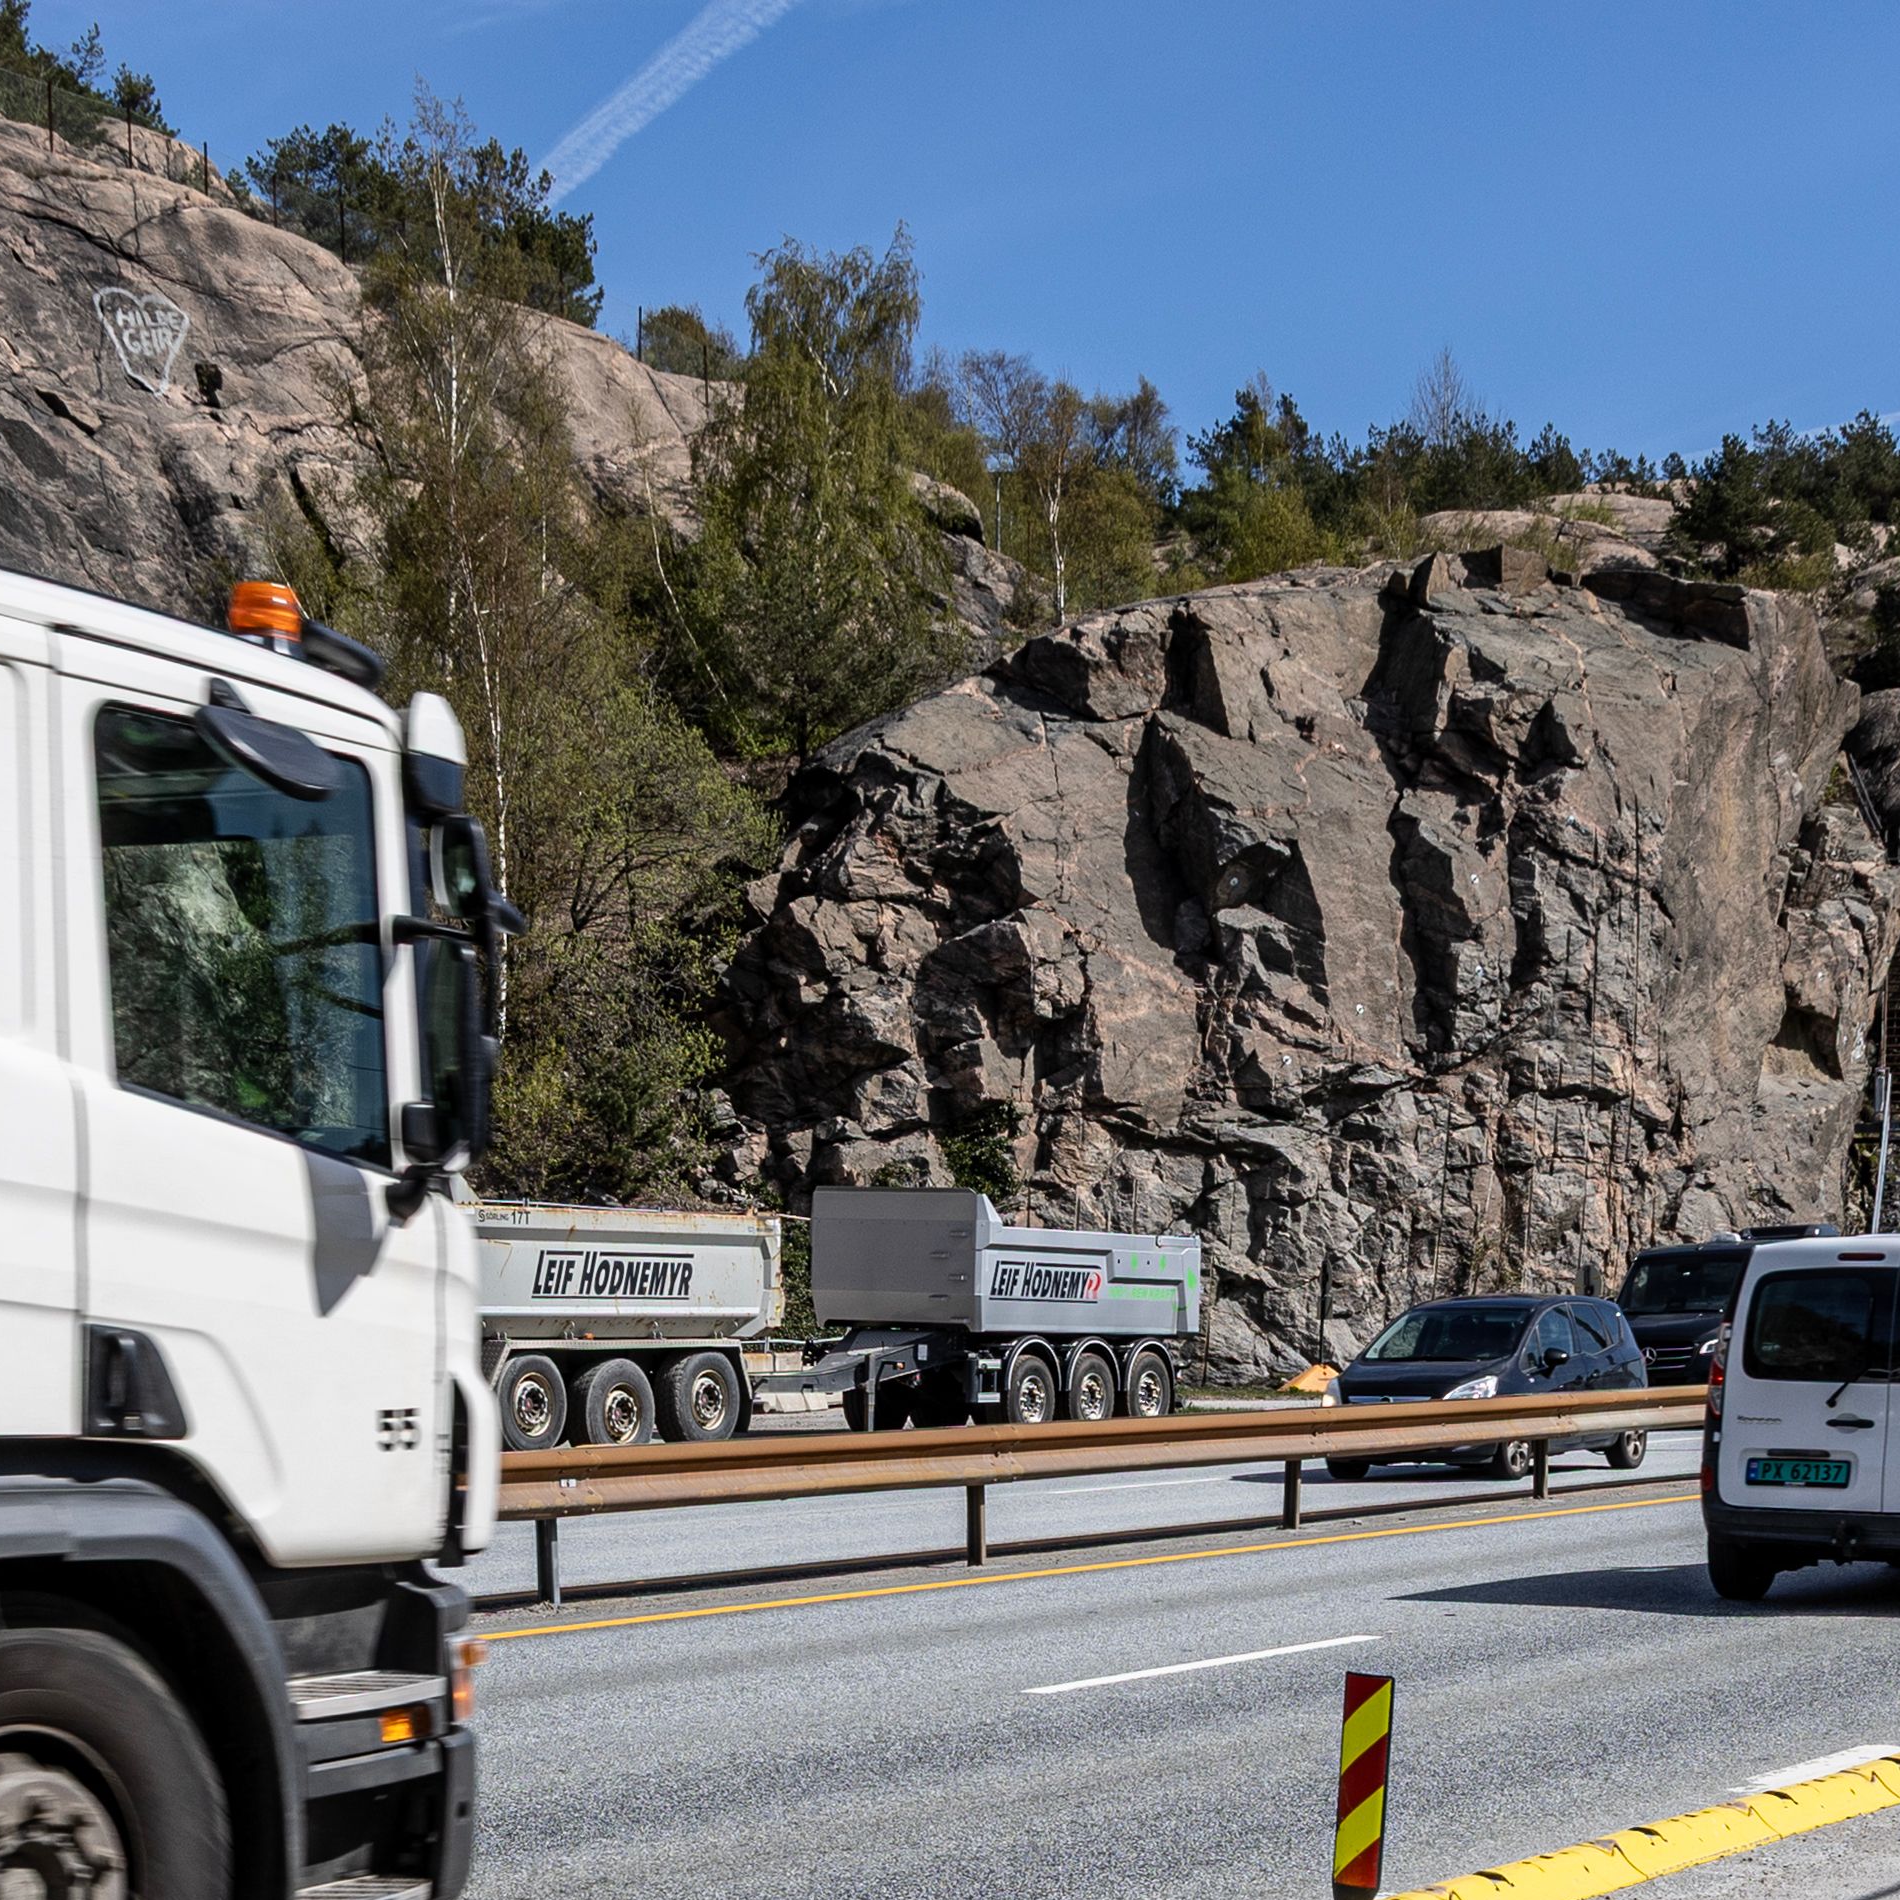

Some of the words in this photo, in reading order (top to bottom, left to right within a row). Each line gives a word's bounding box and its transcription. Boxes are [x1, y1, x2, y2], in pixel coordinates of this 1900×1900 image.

[512, 1209, 531, 1224] 17T
[532, 1250, 575, 1295] LEIF
[578, 1251, 694, 1296] HODNEMYR
[990, 1260, 1020, 1296] LEIF
[1021, 1261, 1101, 1299] HODNEMYR
[1762, 1462, 1784, 1479] PX
[1791, 1463, 1843, 1481] 62137
